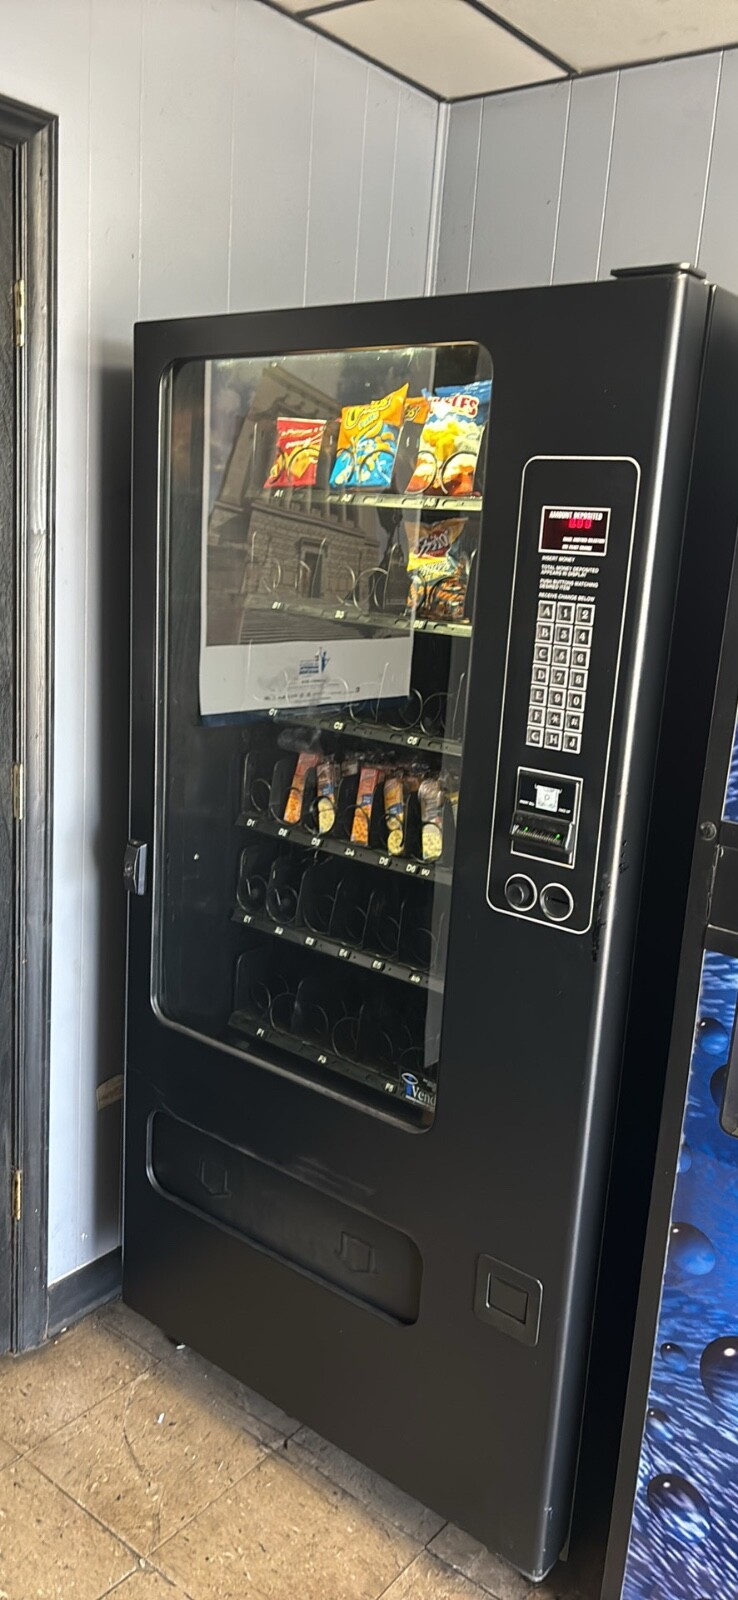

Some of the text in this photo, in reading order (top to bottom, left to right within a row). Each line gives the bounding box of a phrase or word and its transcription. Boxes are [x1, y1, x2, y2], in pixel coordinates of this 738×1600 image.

[274, 490, 284, 498] A1
[543, 607, 589, 620] A 1 2
[541, 628, 585, 642] B 3 4
[539, 648, 546, 658] C
[577, 653, 584, 663] 6
[537, 670, 582, 684] D 7 8
[535, 691, 543, 700] E
[573, 696, 580, 706] 0
[531, 731, 576, 747] G H J
[246, 818, 255, 826] D1
[345, 848, 355, 857] D4
